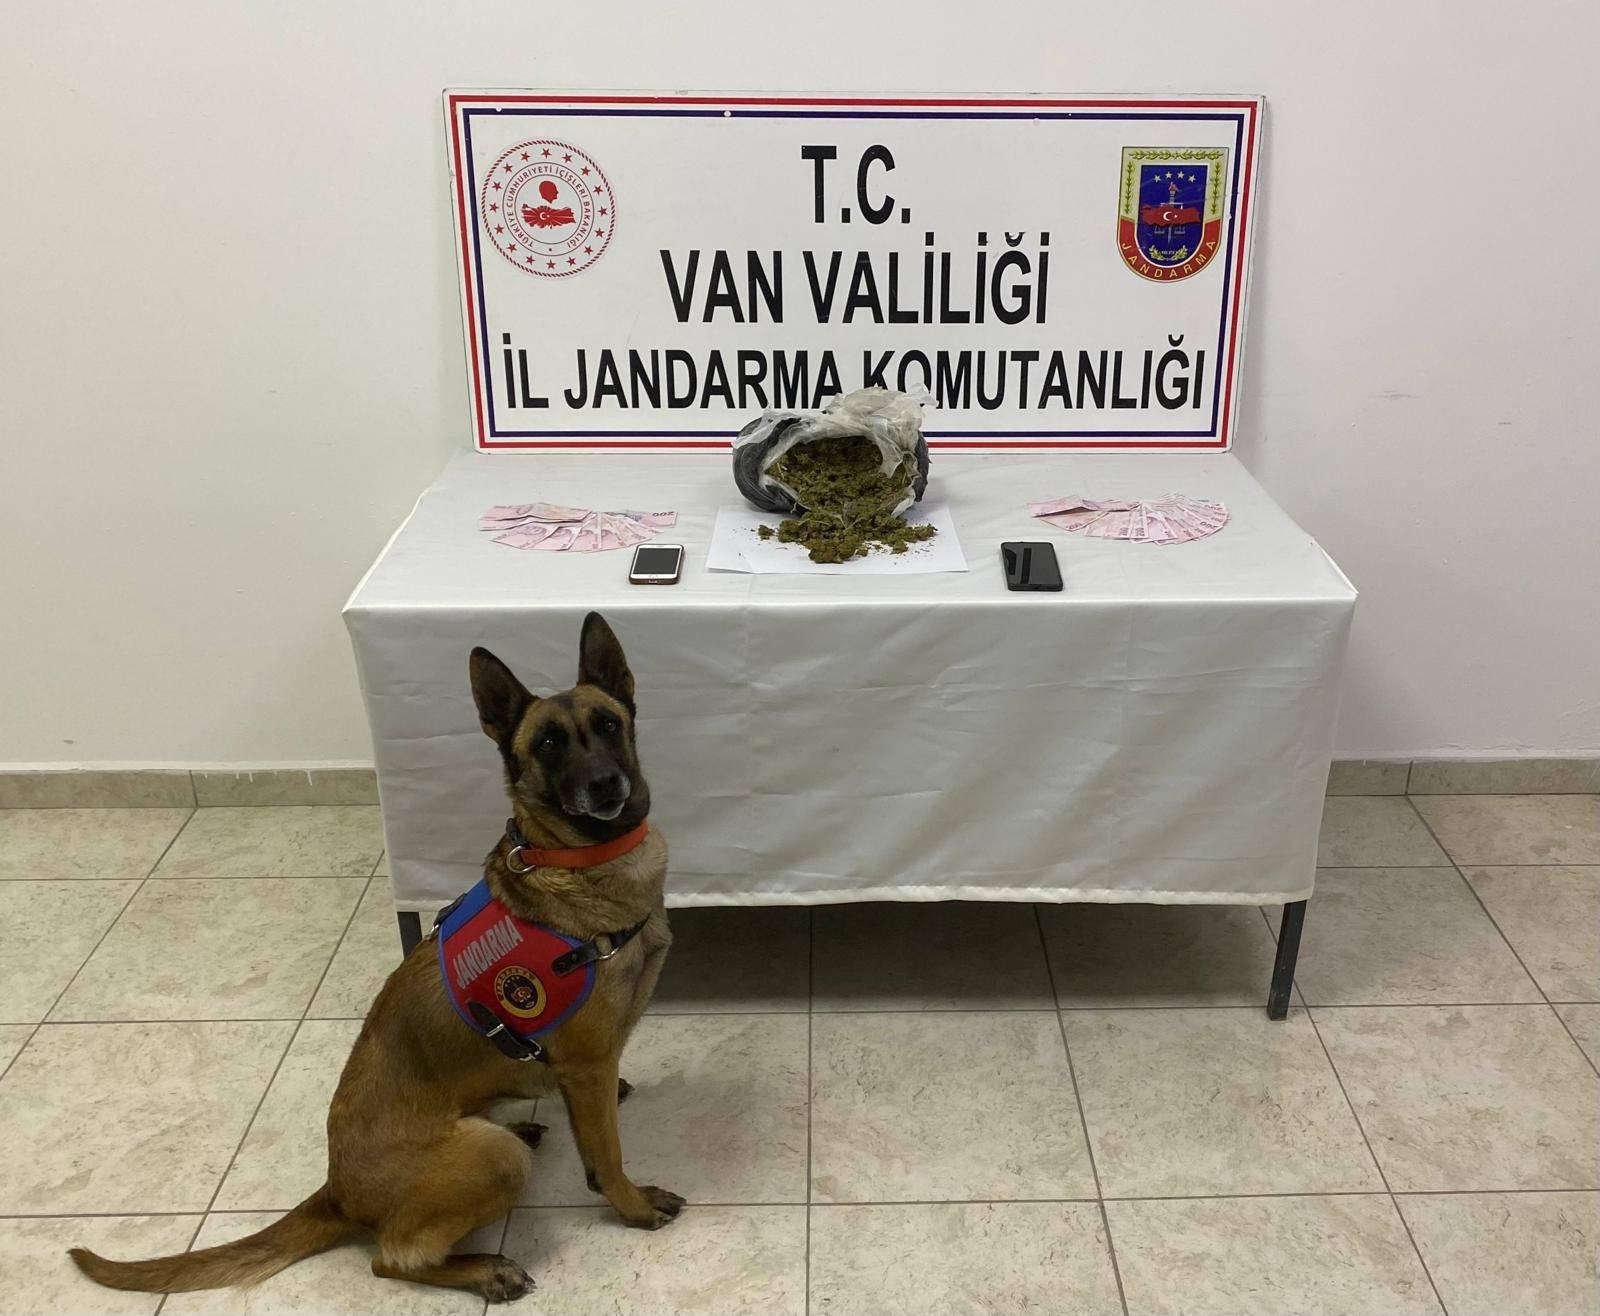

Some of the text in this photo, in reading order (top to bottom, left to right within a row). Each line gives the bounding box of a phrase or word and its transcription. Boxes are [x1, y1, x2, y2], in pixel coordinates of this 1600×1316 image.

[507, 165, 591, 249] TÜRKİYE CUMHURİYETİ İÇİŞLERİ BAKANLIĞI
[801, 144, 911, 225] T.C.
[659, 231, 1050, 325] VAN VALİLİĞİ
[1121, 239, 1217, 279] JANDARMA
[502, 332, 1206, 410] İL JANDARMA KOMUTANLIĞI
[454, 915, 524, 989] JANDARMA
